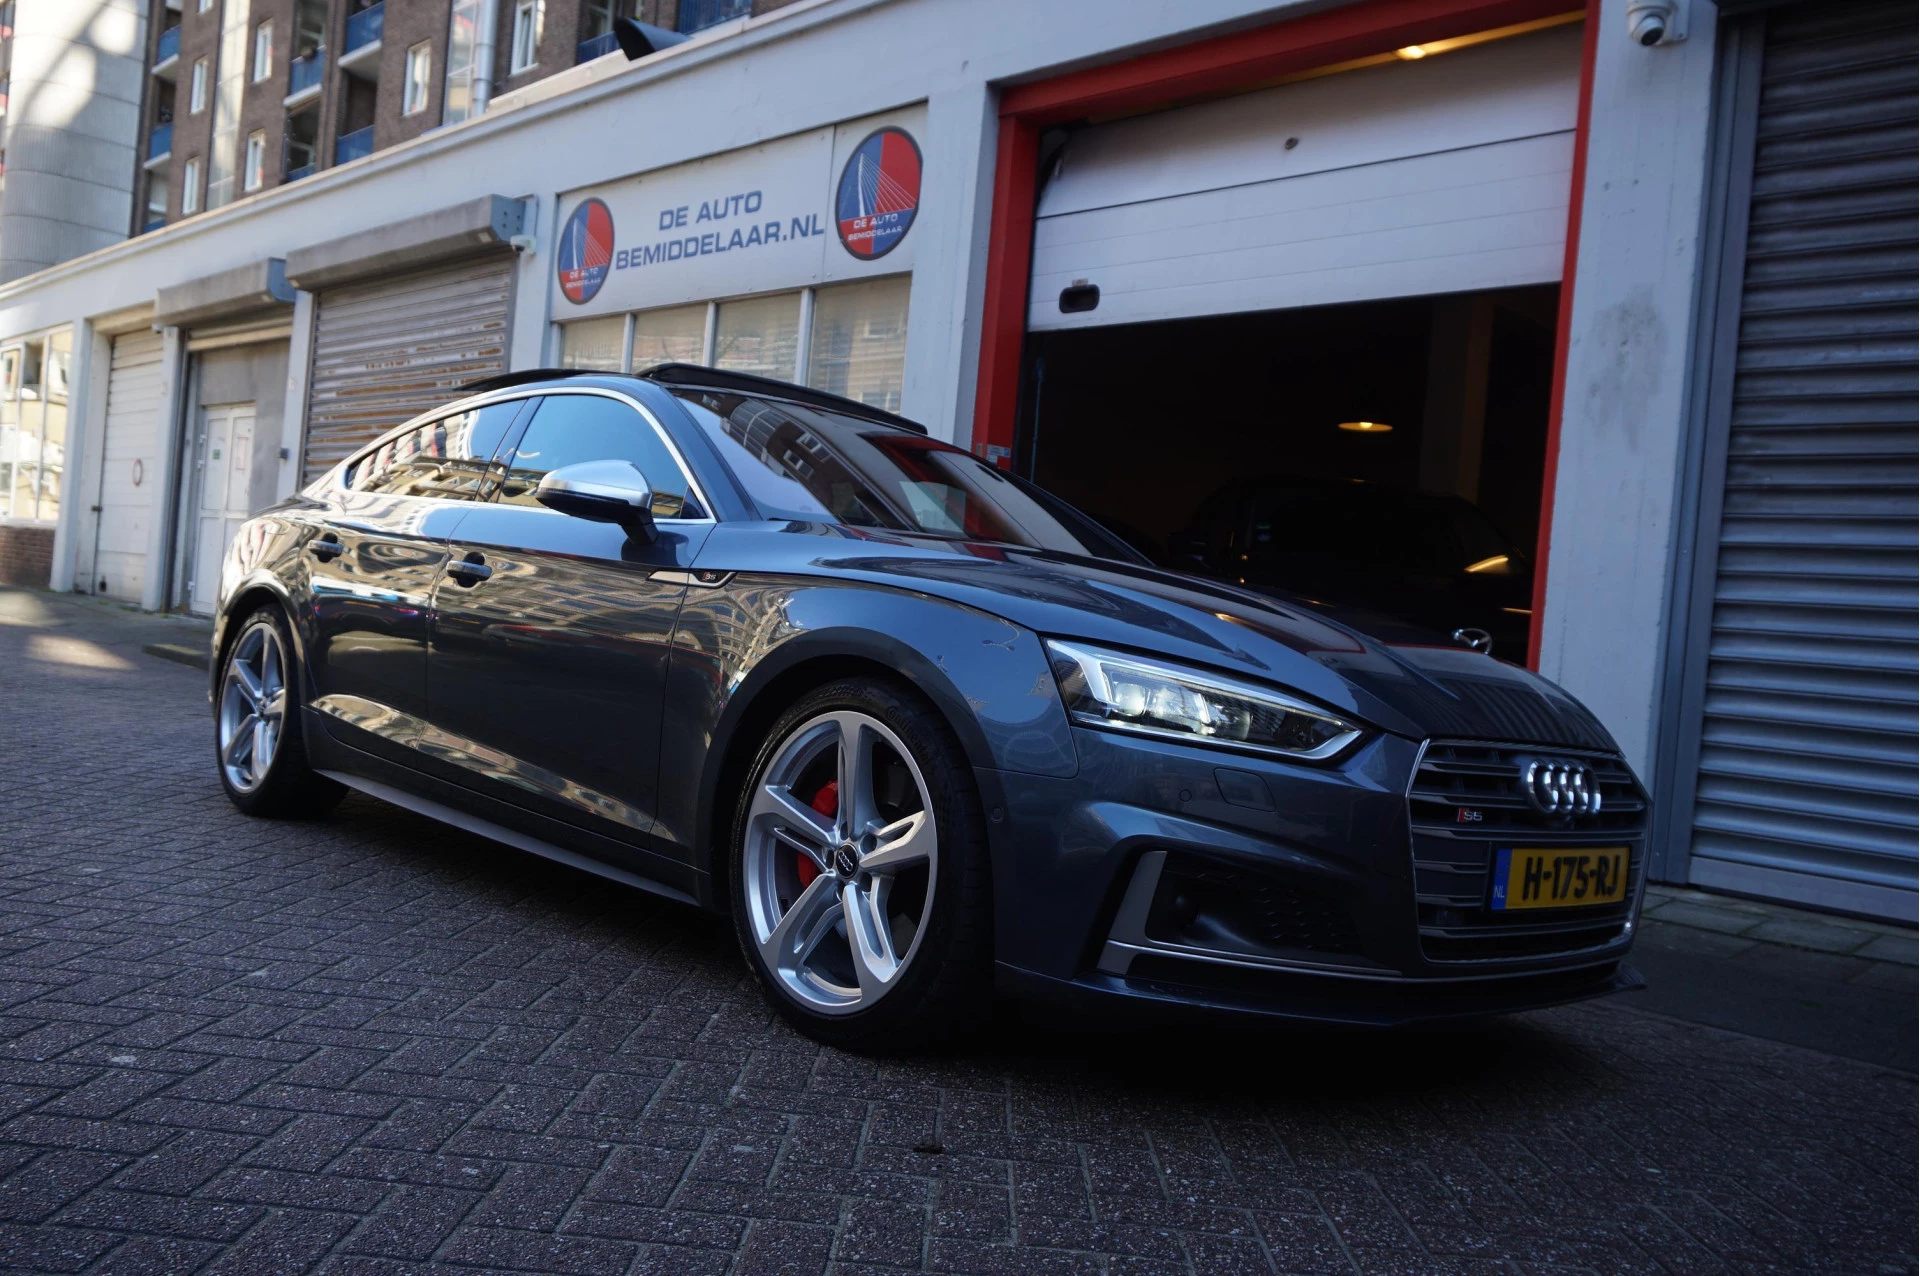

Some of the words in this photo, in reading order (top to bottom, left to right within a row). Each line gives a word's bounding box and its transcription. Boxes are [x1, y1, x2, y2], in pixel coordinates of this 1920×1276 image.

[659, 207, 688, 230] DE
[697, 190, 762, 223] AUTO
[853, 218, 868, 229] DE
[870, 213, 899, 225] AUTO
[847, 226, 903, 241] BEMIDDELAAR
[616, 214, 825, 271] BEMIDDELAAR.NL
[1463, 809, 1483, 822] S5
[1523, 855, 1621, 900] H-175-RJ
[1493, 885, 1505, 898] NL
